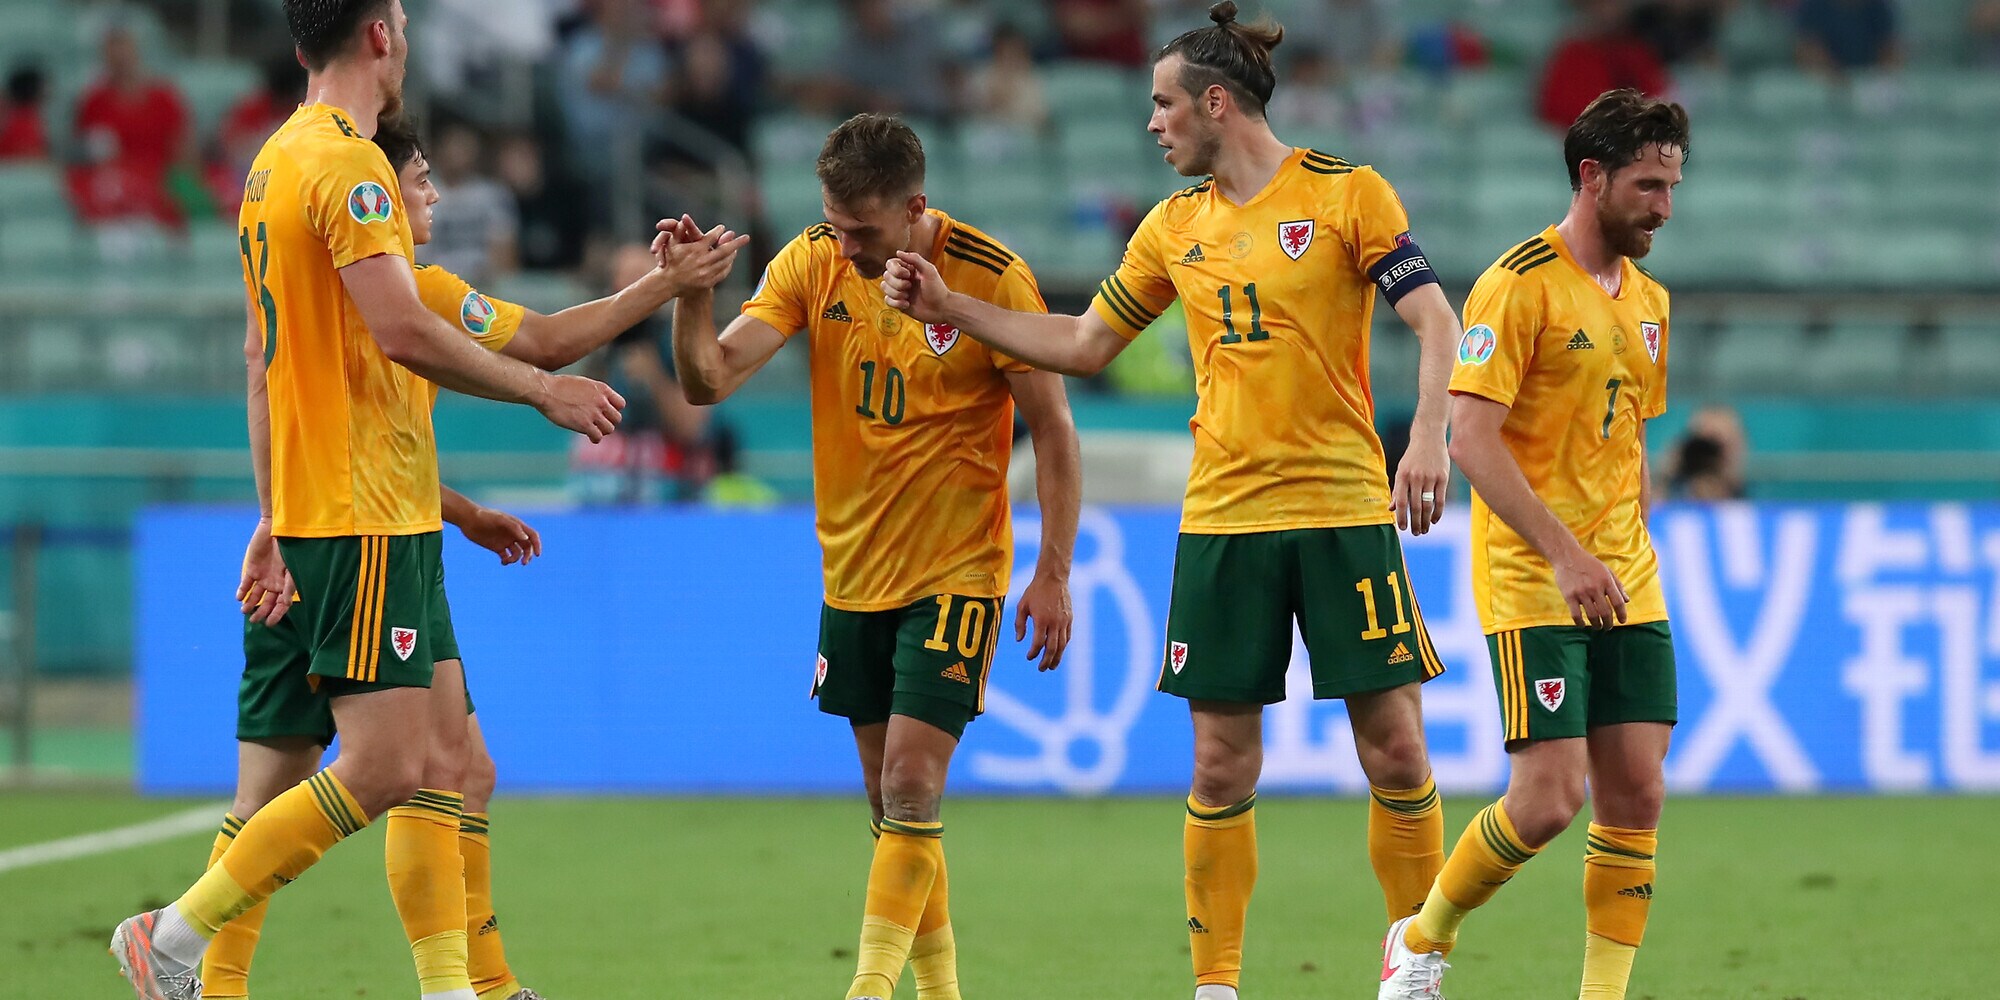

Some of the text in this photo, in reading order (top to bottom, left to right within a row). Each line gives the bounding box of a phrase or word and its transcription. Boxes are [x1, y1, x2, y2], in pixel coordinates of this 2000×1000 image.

[246, 168, 271, 203] MOOR
[1392, 259, 1428, 279] RESPECT
[823, 311, 854, 323] adidas
[1217, 282, 1270, 344] 11
[1566, 341, 1595, 351] adidas
[855, 360, 906, 425] 10
[1602, 378, 1622, 440] 7
[1355, 571, 1411, 641] 11
[923, 593, 987, 659] 10
[1387, 653, 1414, 665] adidas
[940, 670, 971, 684] adidas
